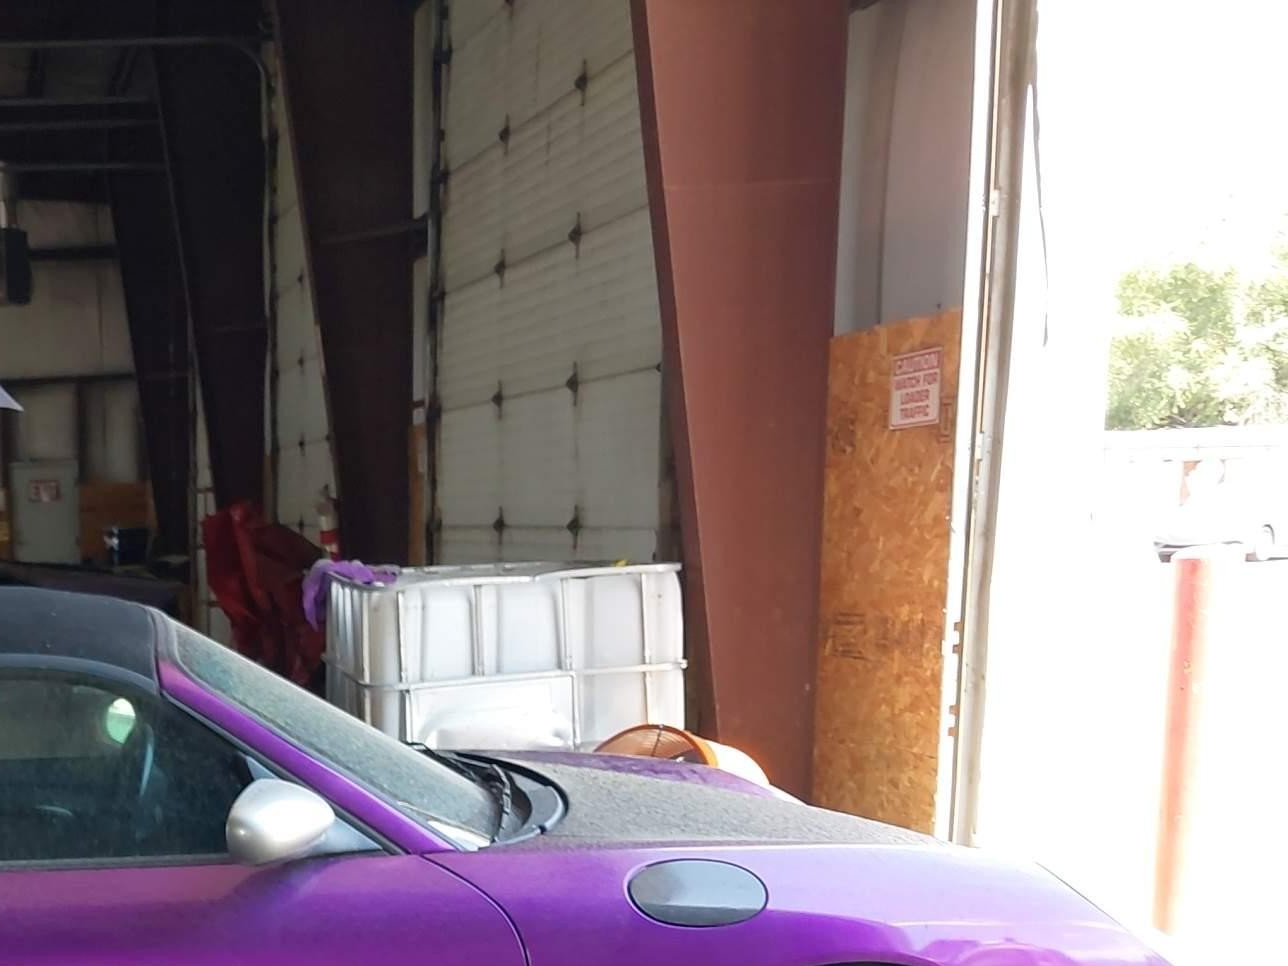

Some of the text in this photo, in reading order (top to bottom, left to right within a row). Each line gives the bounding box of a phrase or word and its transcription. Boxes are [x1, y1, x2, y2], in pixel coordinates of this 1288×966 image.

[895, 353, 939, 376] CAUTION
[894, 372, 938, 391] WATCH FOR
[900, 388, 930, 406] LOADER
[900, 404, 930, 421] TRAFFIC
